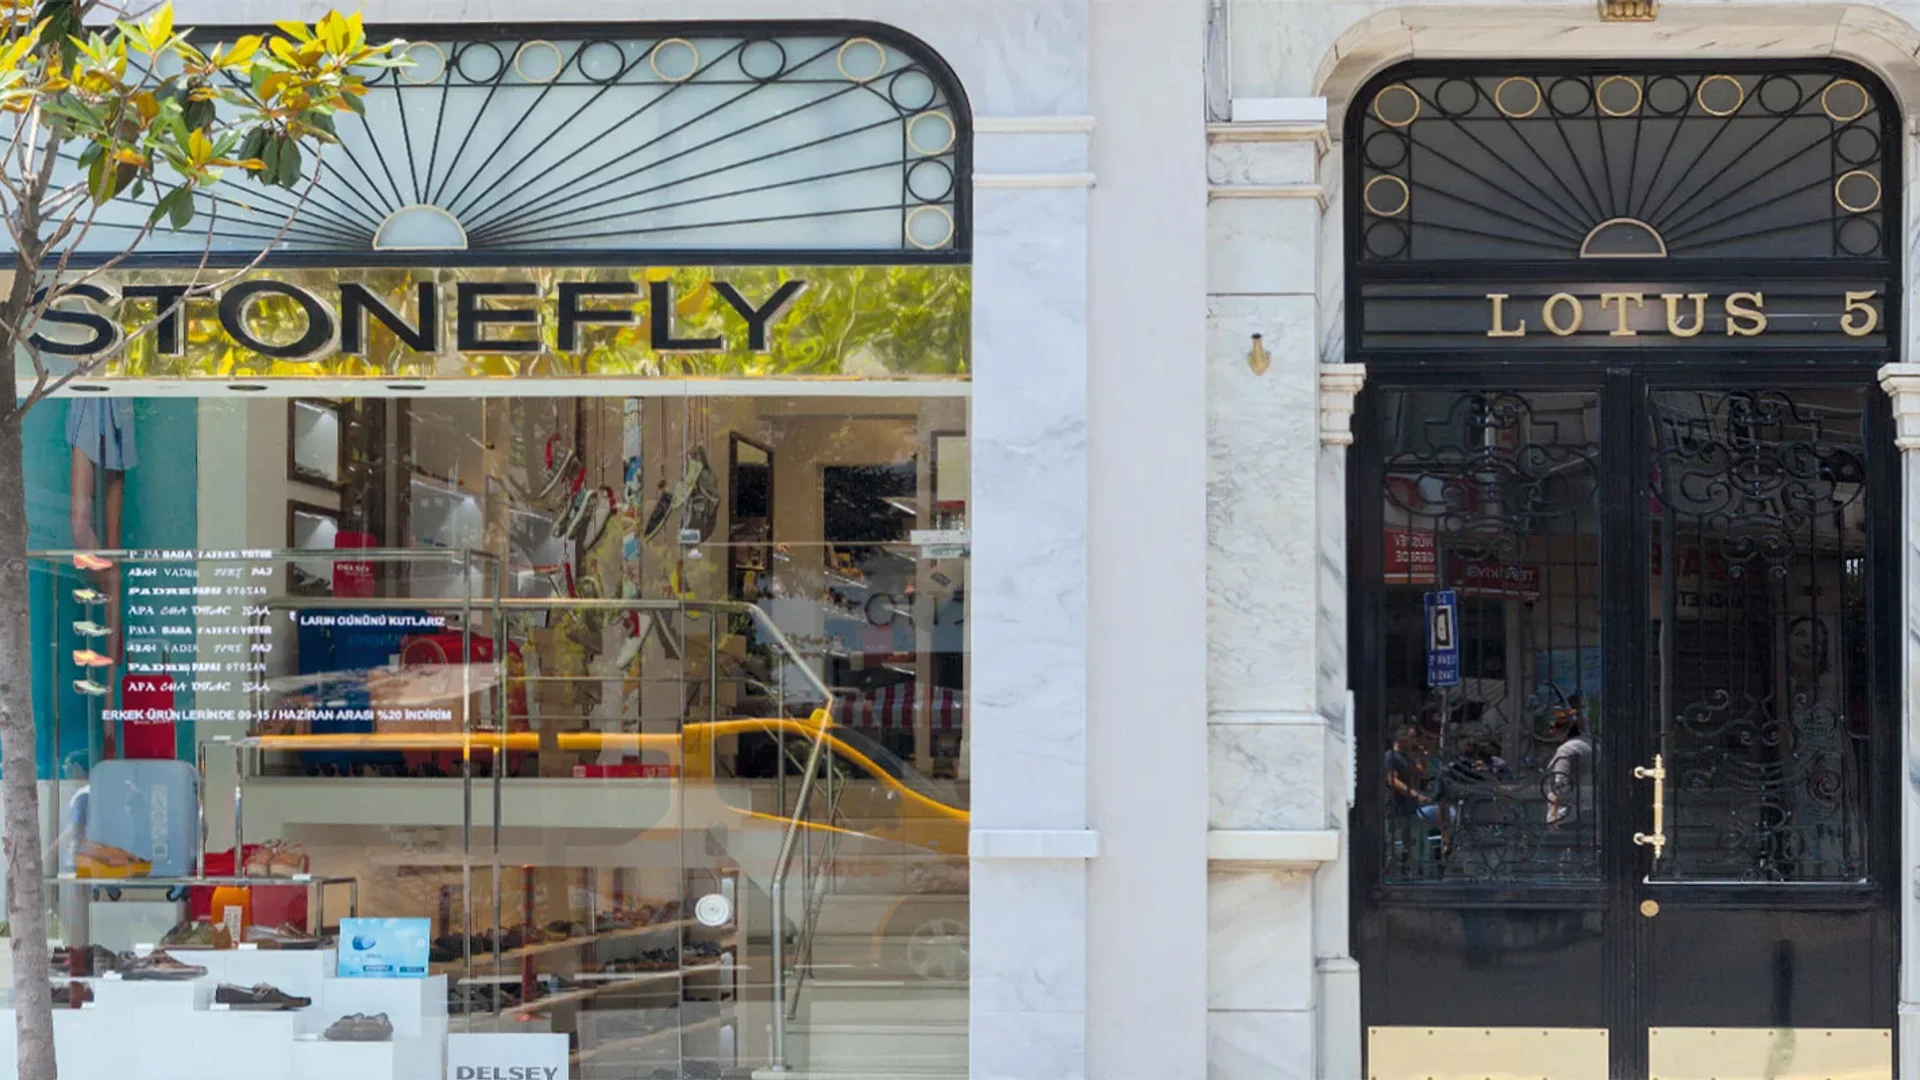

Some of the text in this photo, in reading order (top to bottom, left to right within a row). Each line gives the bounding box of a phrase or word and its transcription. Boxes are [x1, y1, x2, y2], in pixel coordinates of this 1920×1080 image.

[29, 278, 807, 357] STONEFLY
[1486, 290, 1878, 337] LOTUS 5
[129, 550, 157, 559] PPA
[128, 587, 191, 596] PADRE
[128, 606, 155, 616] APA
[388, 616, 446, 627] KUTLARIZ
[128, 662, 191, 672] PADRE
[128, 682, 157, 692] APA
[102, 709, 143, 721] ERKEK
[238, 709, 270, 721] 09-15
[336, 709, 374, 721] ARASI
[377, 709, 402, 721] %20
[456, 1066, 558, 1080] DELSEY
